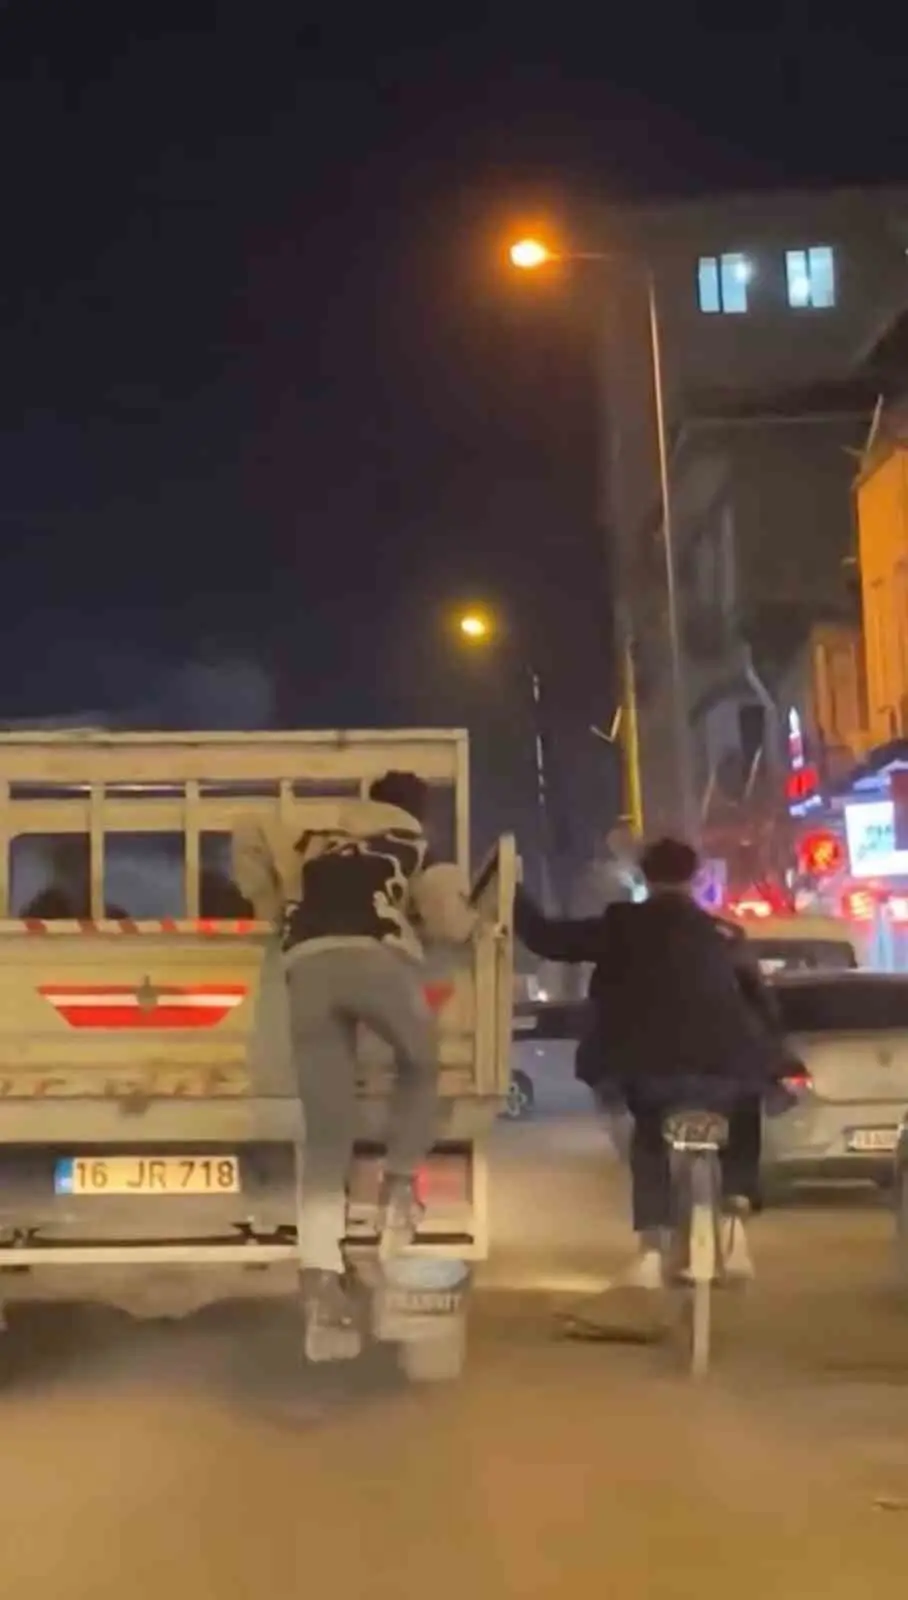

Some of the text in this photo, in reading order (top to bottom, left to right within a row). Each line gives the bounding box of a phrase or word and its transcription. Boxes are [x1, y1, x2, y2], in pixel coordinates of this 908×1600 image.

[76, 1160, 234, 1188] 16 JR 718
